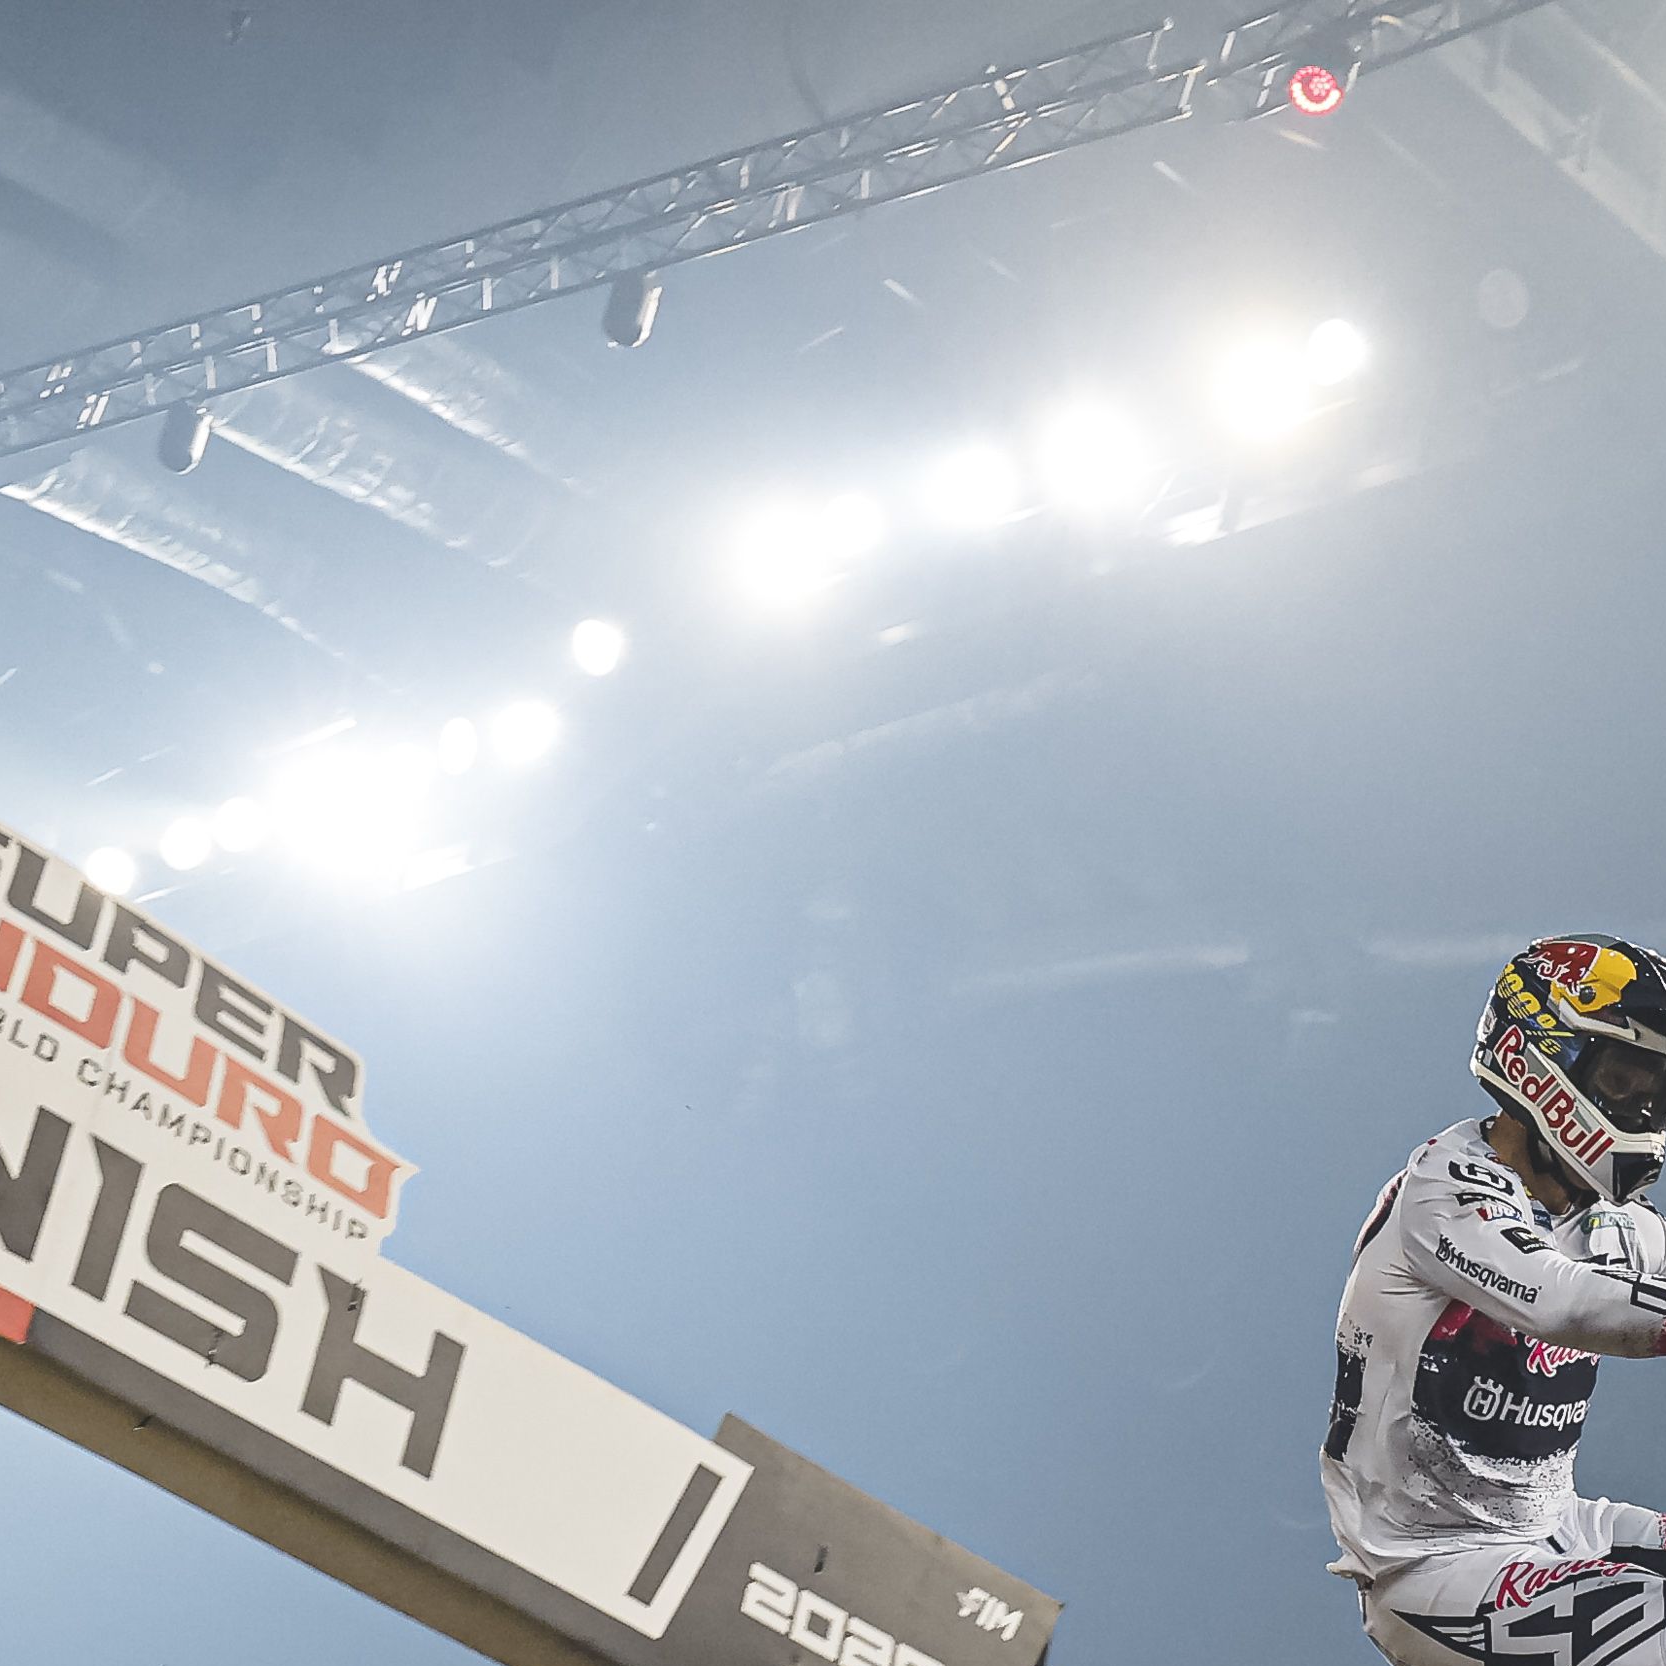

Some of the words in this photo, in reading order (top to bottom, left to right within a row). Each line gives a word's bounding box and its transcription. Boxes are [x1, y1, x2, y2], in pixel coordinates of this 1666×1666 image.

[75, 1058, 369, 1241] CHAMPIONSHIP
[1450, 1246, 1542, 1304] Husqvarna
[1499, 1392, 1589, 1432] Husqva
[956, 1586, 1024, 1642] FIM
